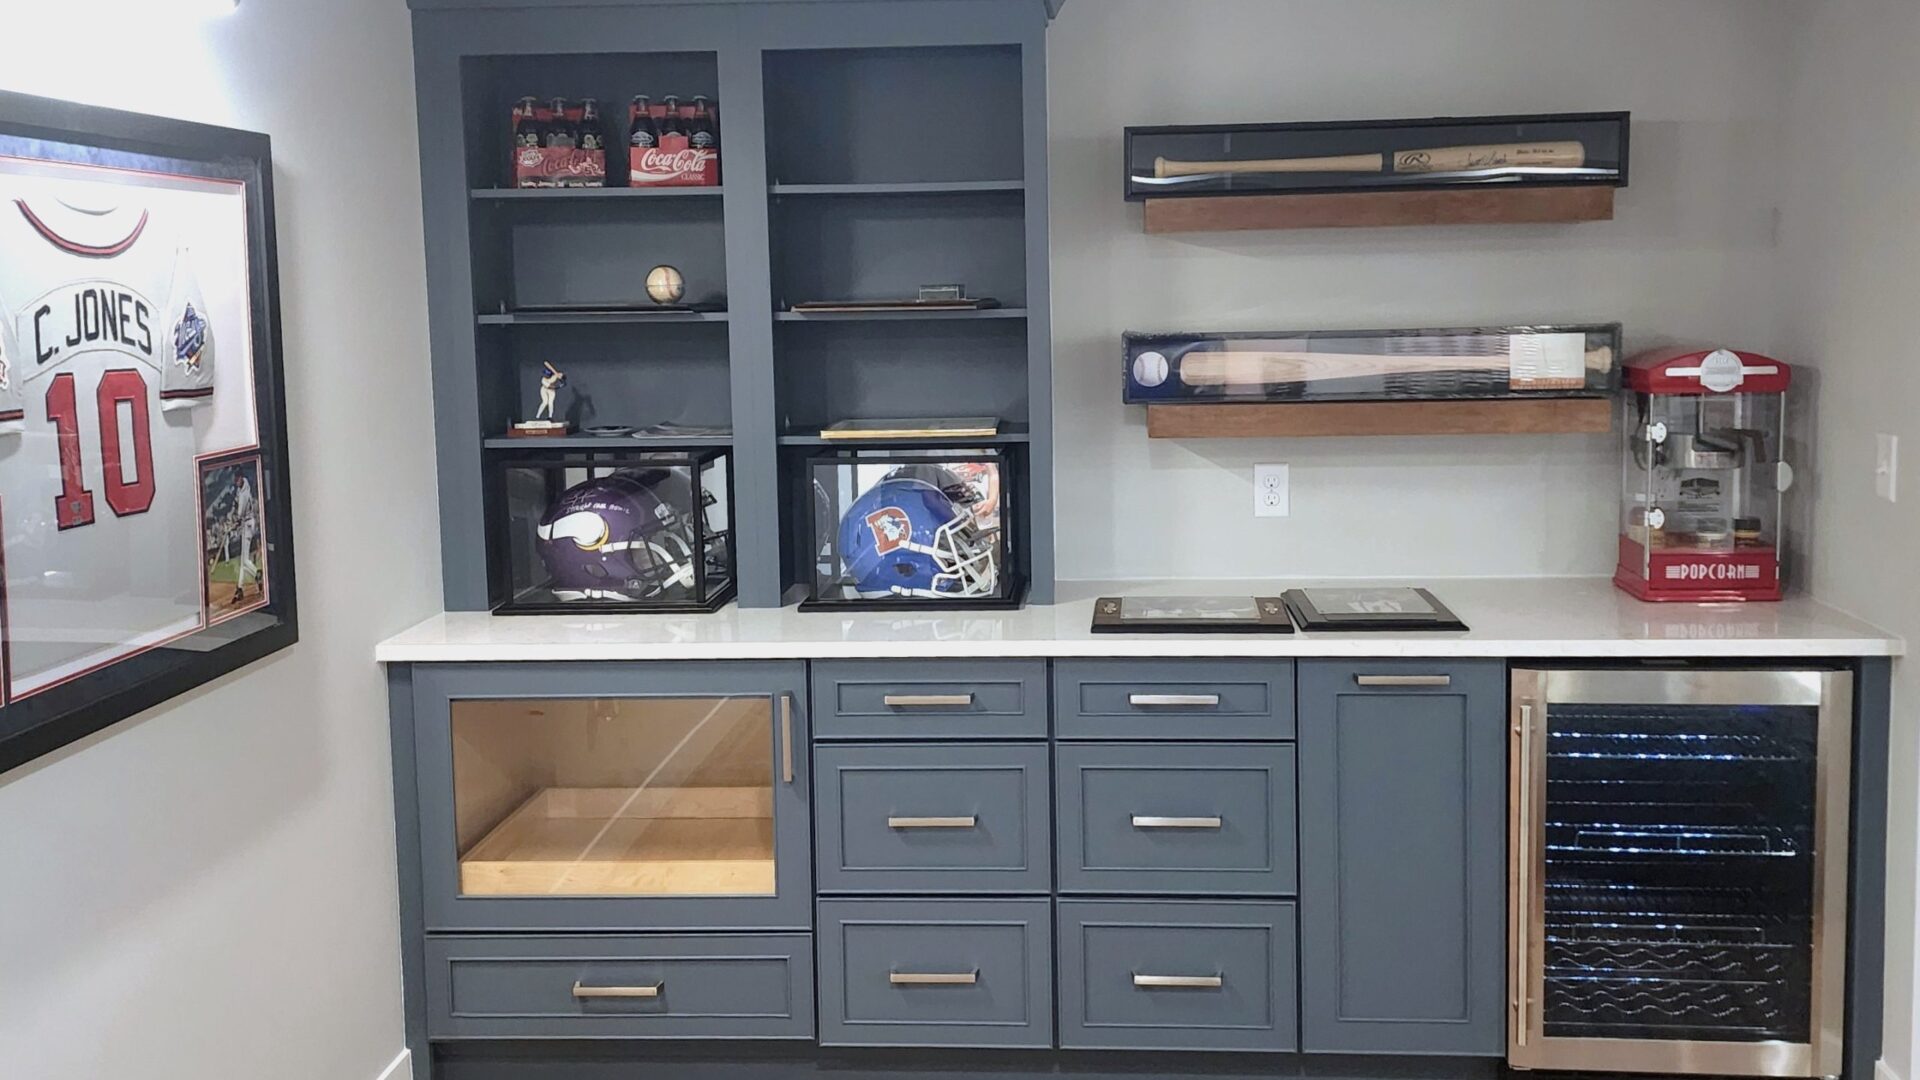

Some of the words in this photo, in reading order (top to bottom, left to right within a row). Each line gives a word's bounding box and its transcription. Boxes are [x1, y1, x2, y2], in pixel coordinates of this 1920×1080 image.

[641, 148, 706, 172] Coca-Cola
[681, 173, 705, 181] CLASSIC
[34, 304, 60, 364] C.
[66, 289, 152, 355] JONES
[45, 368, 156, 531] 10
[1681, 564, 1745, 579] POPCORN
